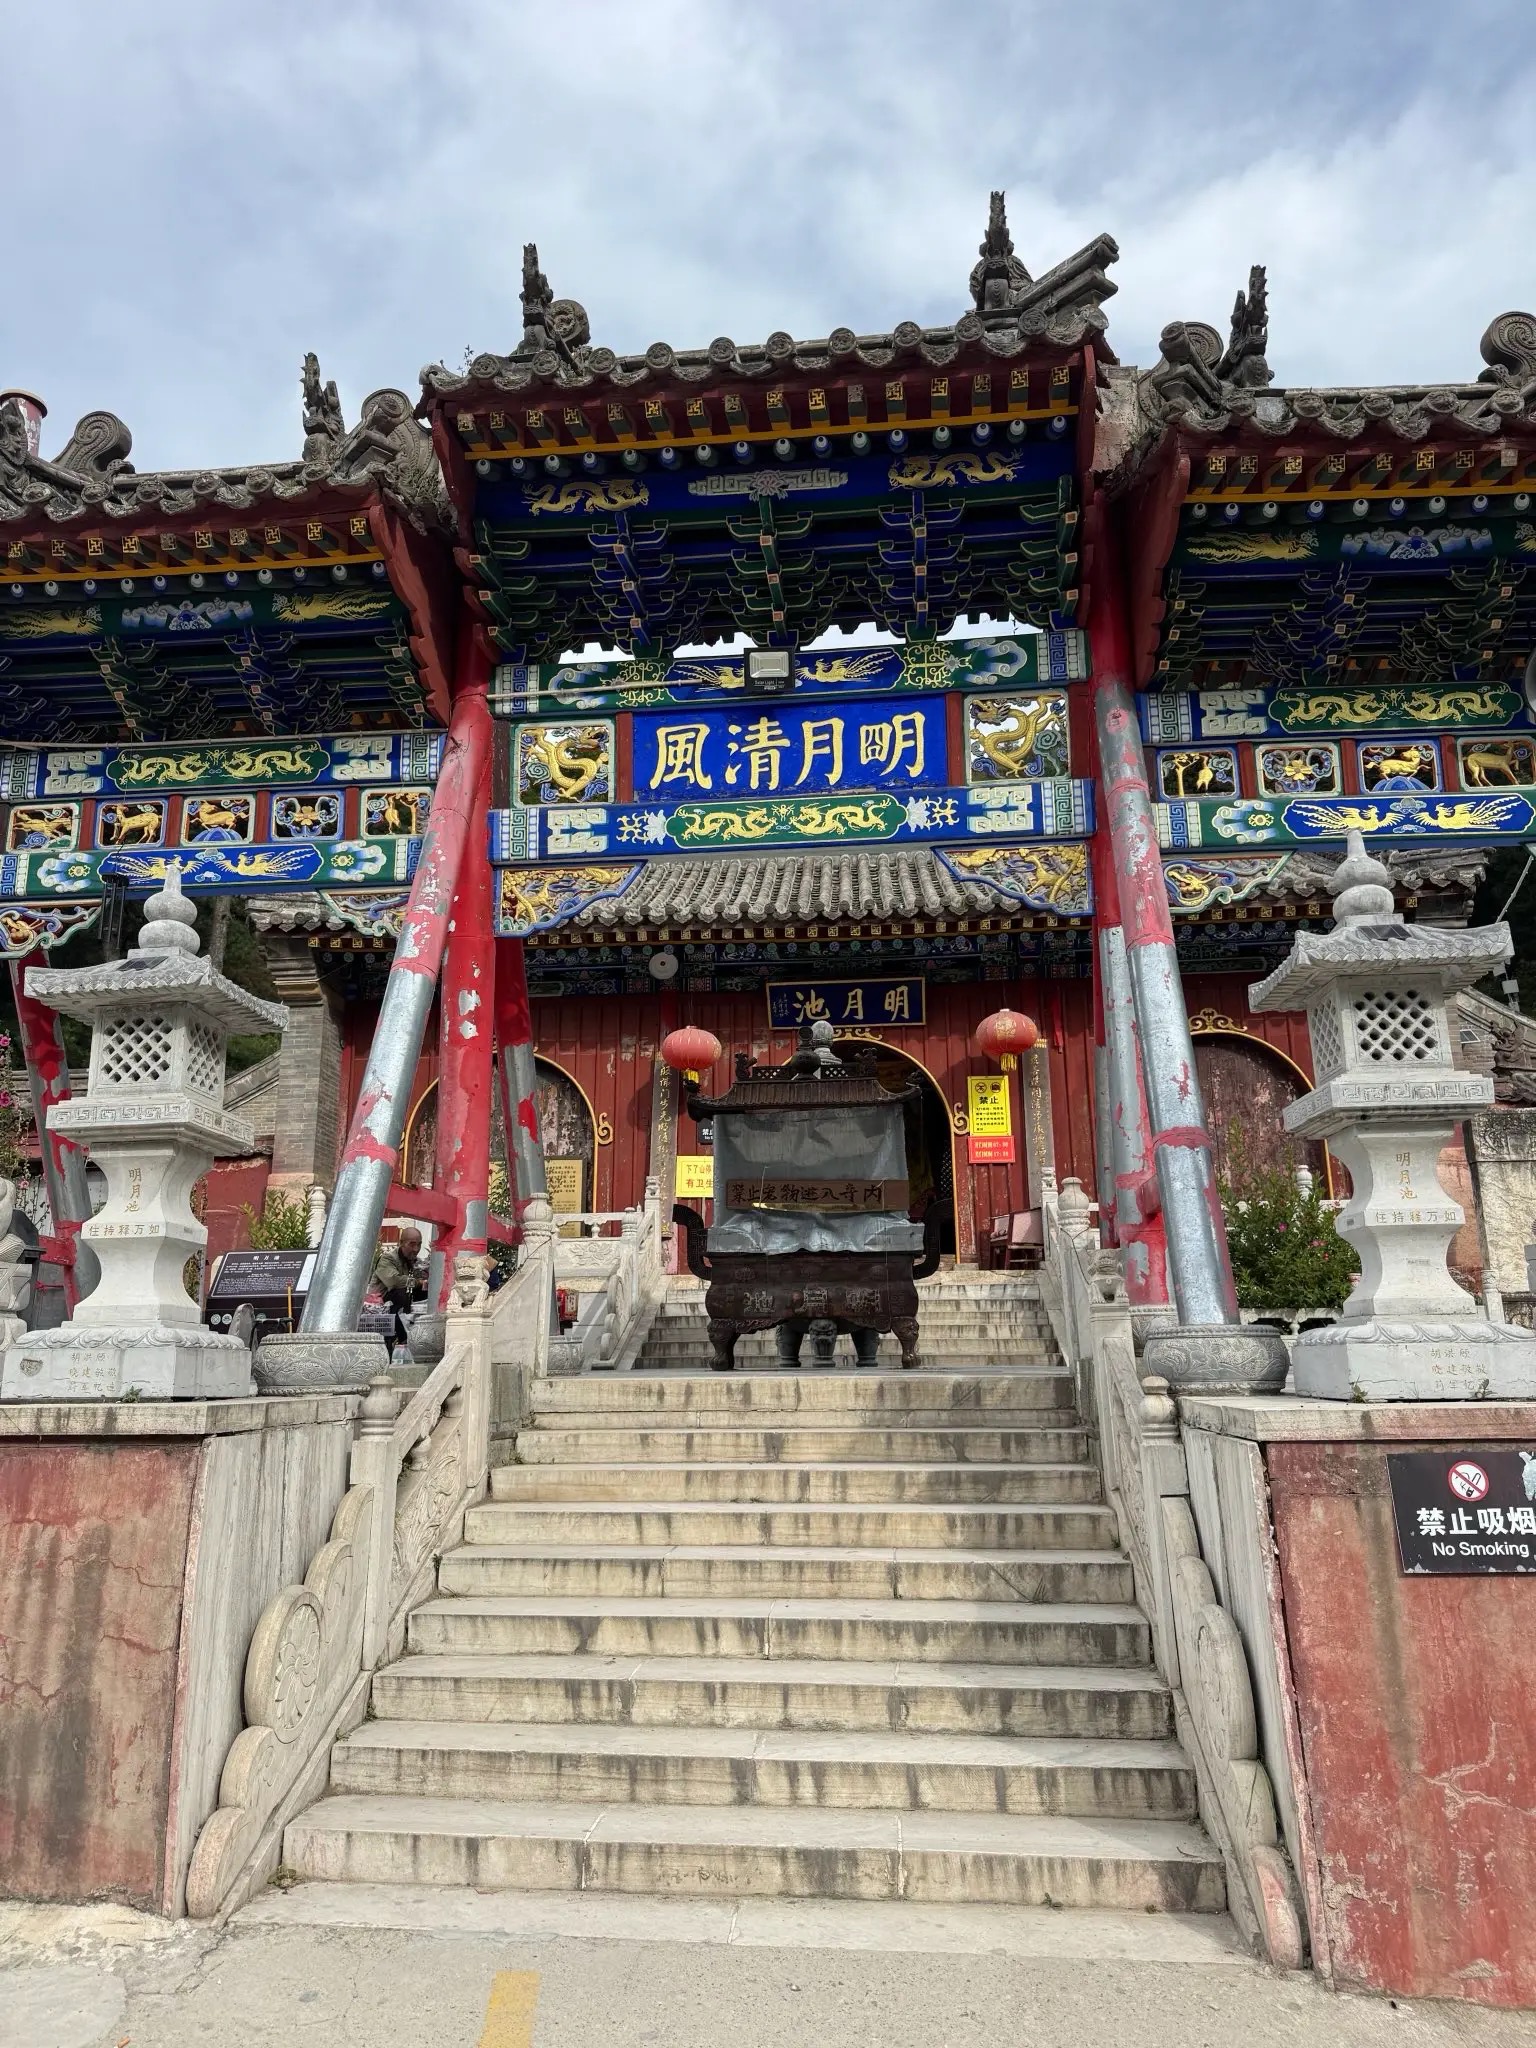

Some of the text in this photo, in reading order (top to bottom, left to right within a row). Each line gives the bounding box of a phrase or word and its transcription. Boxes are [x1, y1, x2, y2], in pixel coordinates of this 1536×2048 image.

[793, 985, 910, 1022] 明月池
[979, 1096, 999, 1104] 禁止
[125, 1167, 142, 1213] 明月池
[1396, 1151, 1418, 1200] 明月池
[1417, 1507, 1536, 1536] 禁止吸烟
[1432, 1541, 1530, 1558] No Smoking
